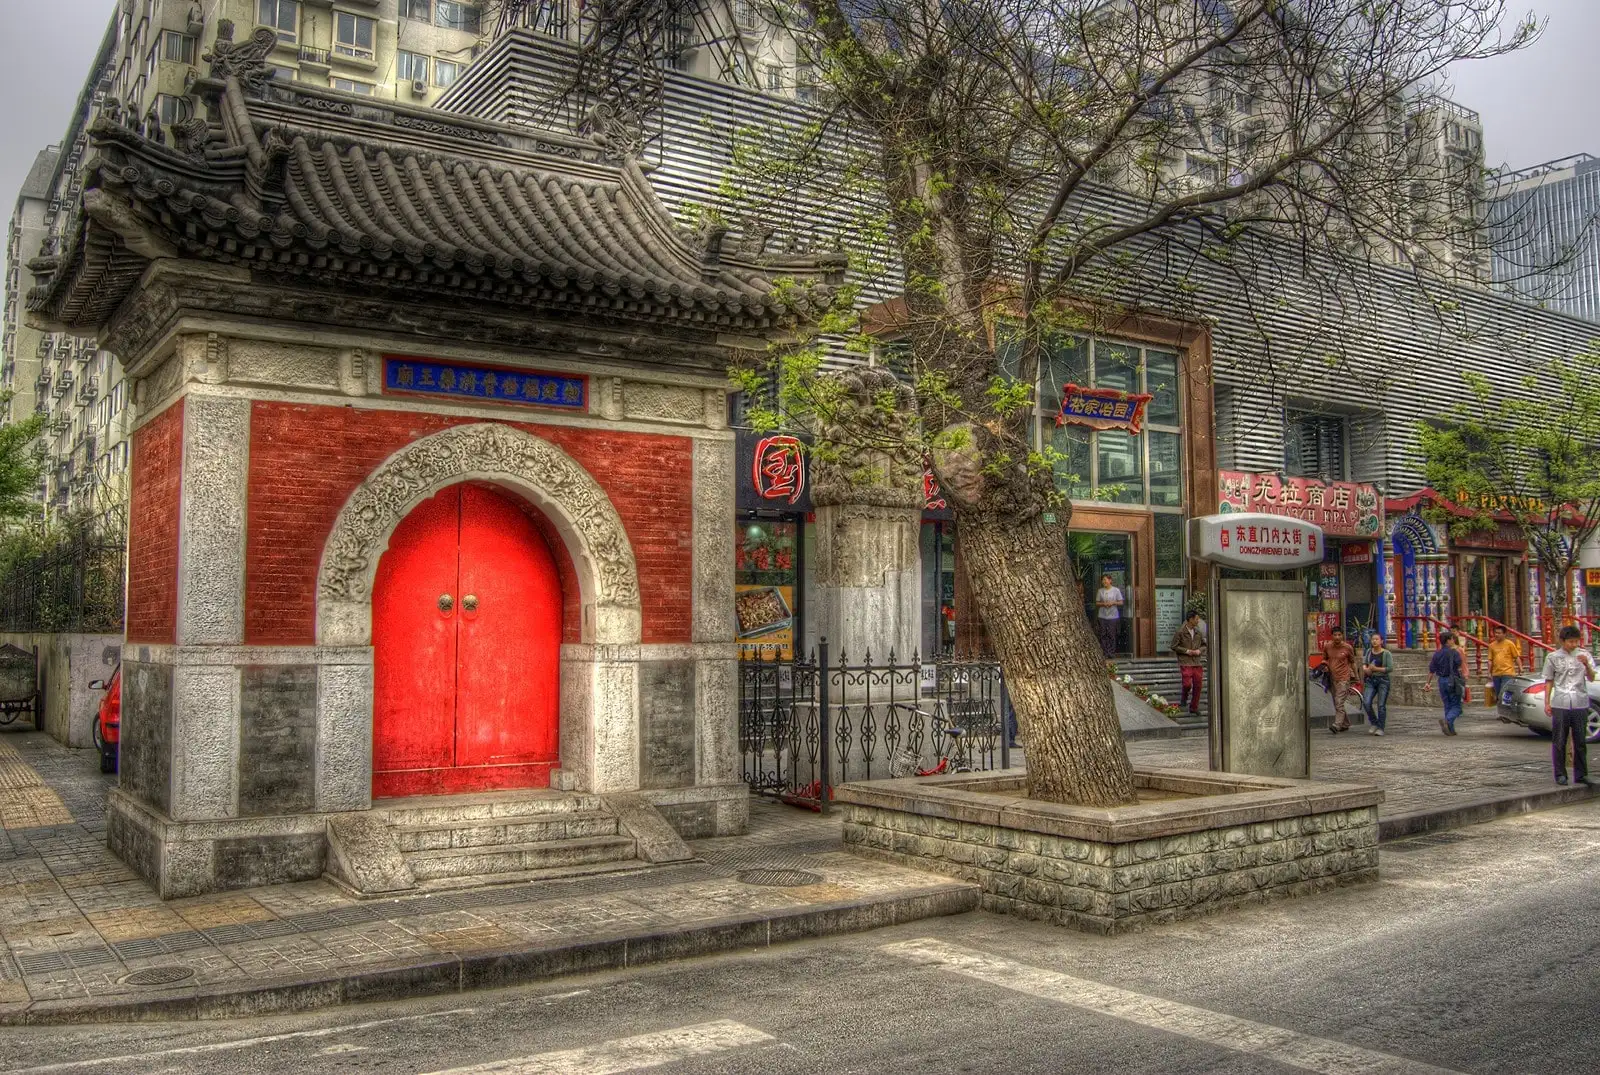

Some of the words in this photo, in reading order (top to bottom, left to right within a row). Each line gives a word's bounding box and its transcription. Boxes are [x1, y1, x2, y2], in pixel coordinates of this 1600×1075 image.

[1236, 525, 1302, 545] 东直门内大街
